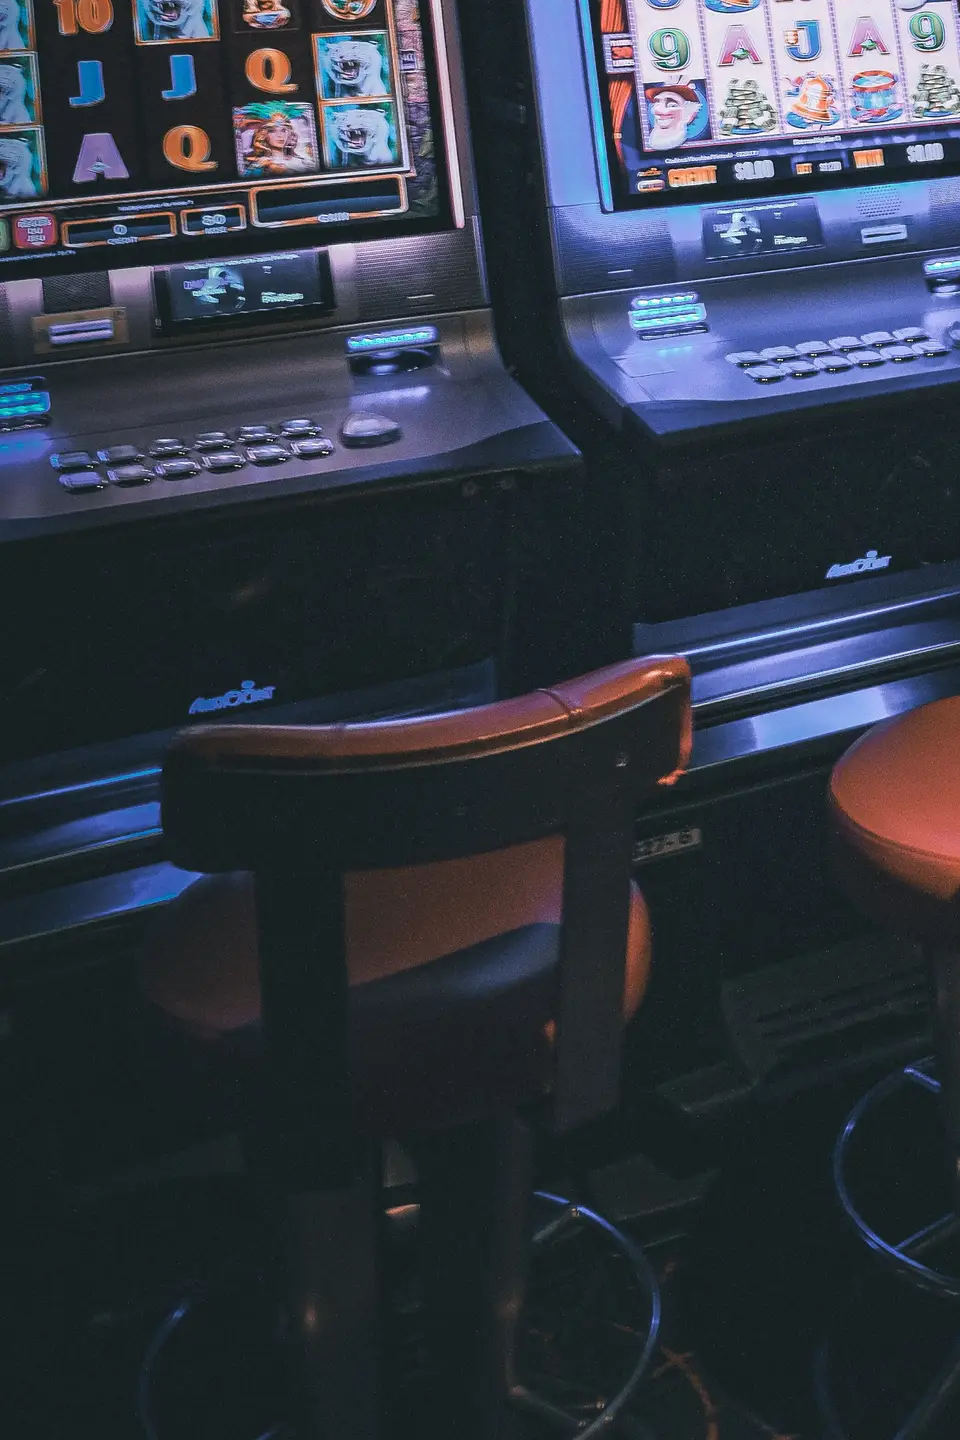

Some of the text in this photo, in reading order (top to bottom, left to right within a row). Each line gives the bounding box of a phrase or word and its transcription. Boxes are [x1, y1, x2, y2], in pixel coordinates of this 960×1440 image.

[648, 10, 947, 71] 9 A J A 9
[69, 47, 299, 108] J J Q
[72, 124, 218, 185] A Q
